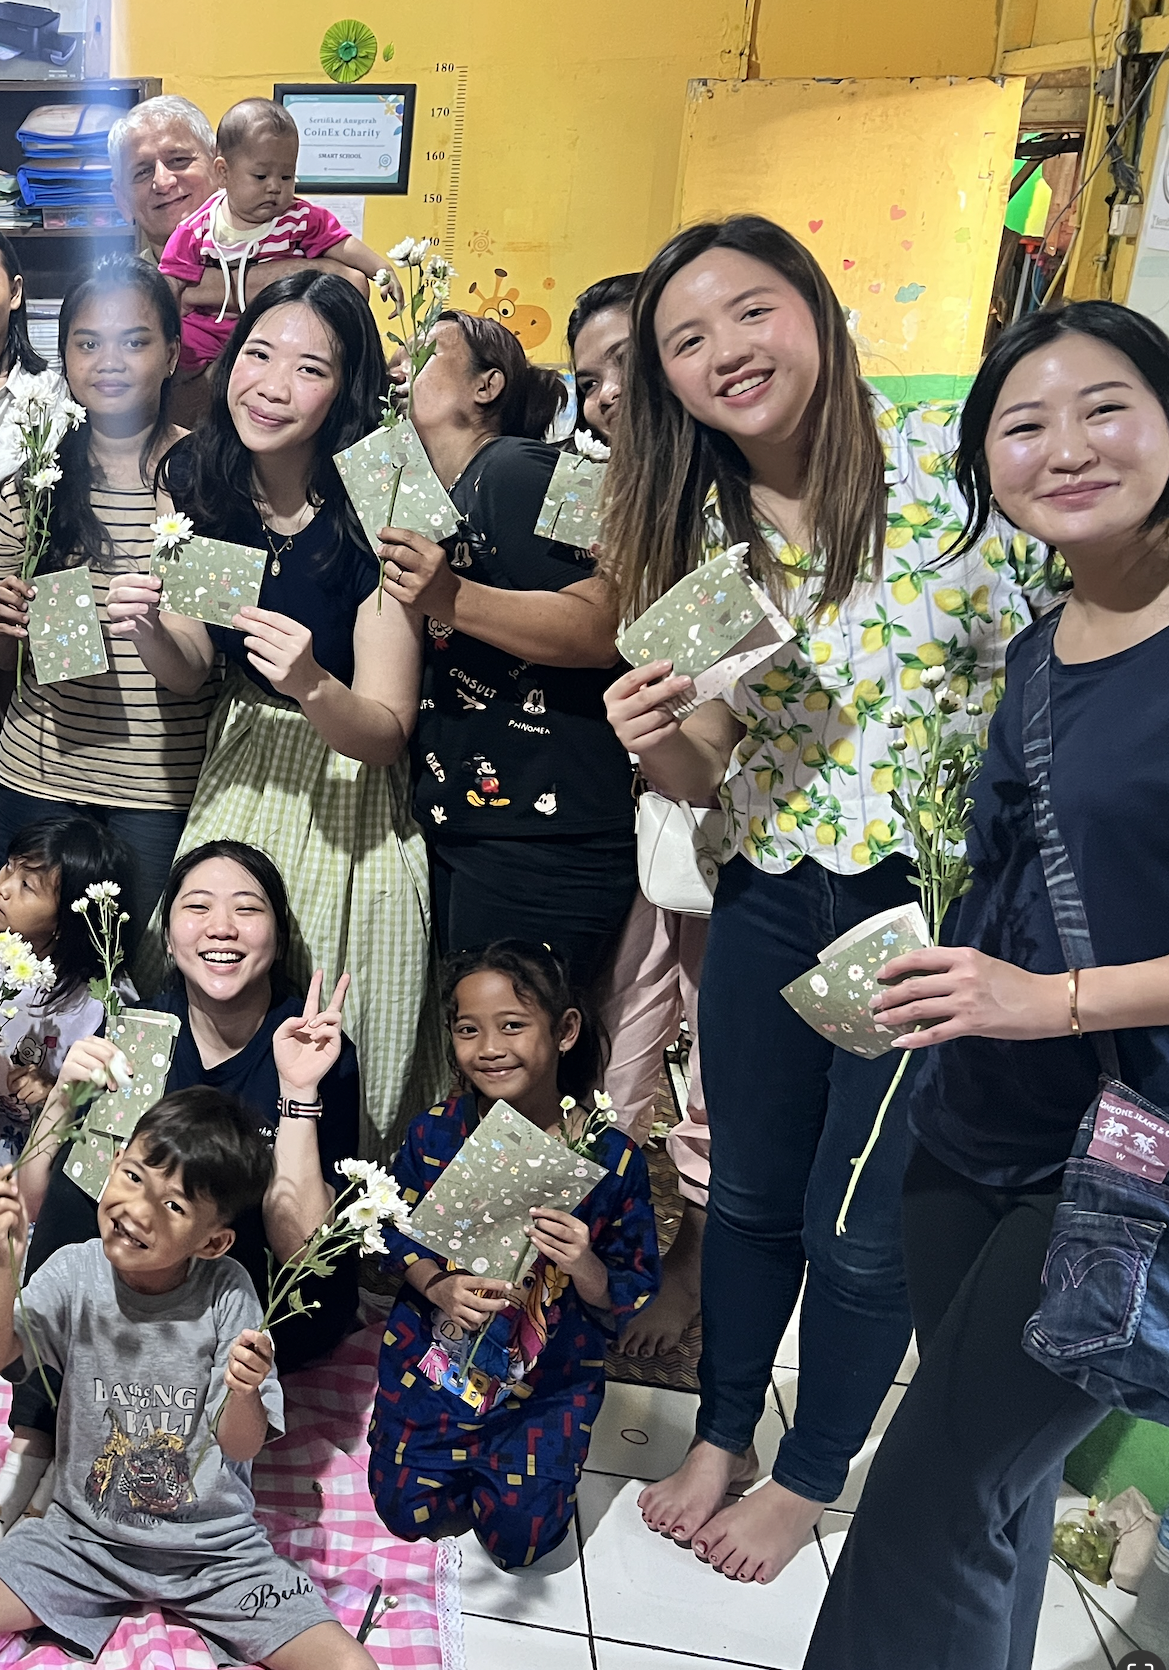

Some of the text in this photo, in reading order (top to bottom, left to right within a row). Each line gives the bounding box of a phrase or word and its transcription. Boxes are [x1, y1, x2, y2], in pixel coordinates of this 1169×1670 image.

[435, 63, 454, 72] 180
[431, 107, 450, 118] 170
[344, 117, 377, 126] Anugerah
[304, 128, 381, 139] CoinEx Charity
[426, 151, 445, 161] 160
[423, 193, 442, 203] 150
[449, 667, 497, 699] CONSULT
[1133, 1112, 1159, 1132] JEANS
[1116, 1152, 1127, 1161] W
[1141, 1164, 1148, 1172] L
[125, 1409, 193, 1437] BALI
